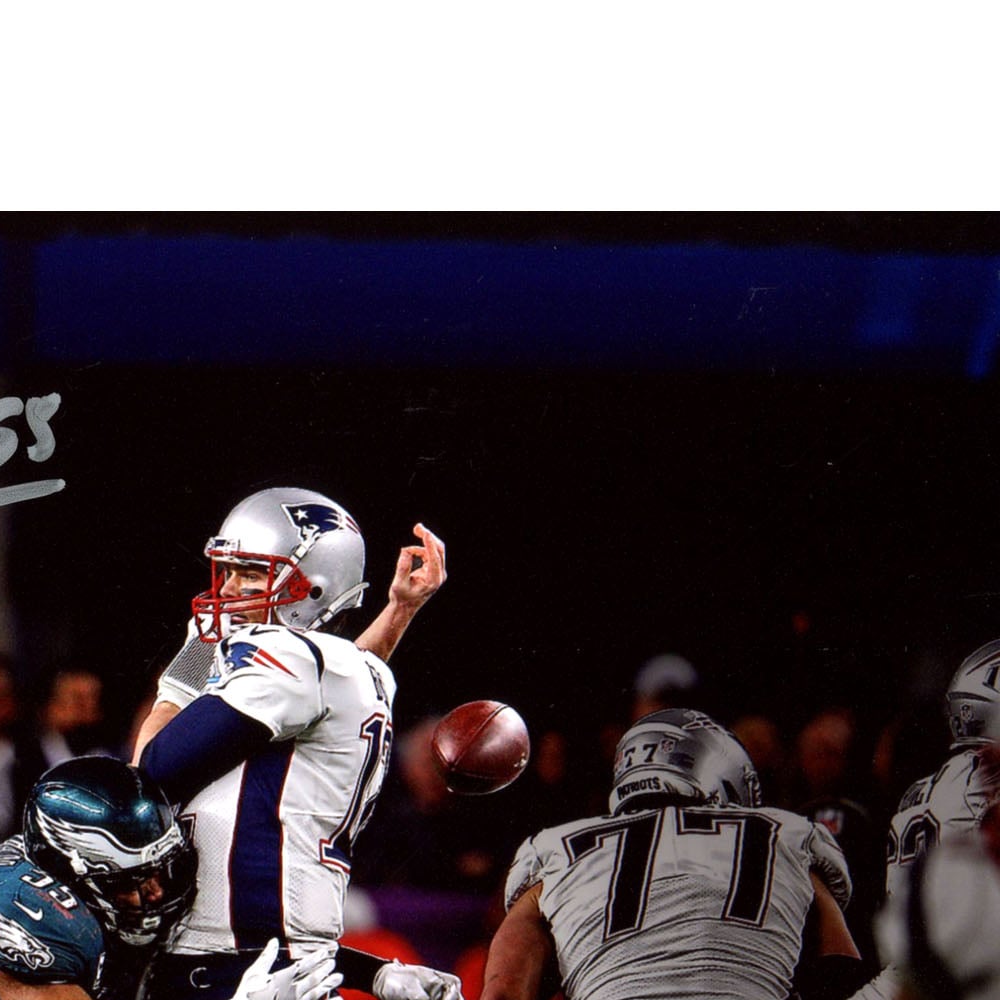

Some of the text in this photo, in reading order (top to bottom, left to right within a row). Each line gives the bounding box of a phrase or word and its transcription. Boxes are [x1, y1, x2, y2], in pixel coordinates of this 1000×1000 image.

[624, 743, 658, 769] 77
[617, 776, 661, 801] PATRIOTS
[562, 806, 782, 943] 77
